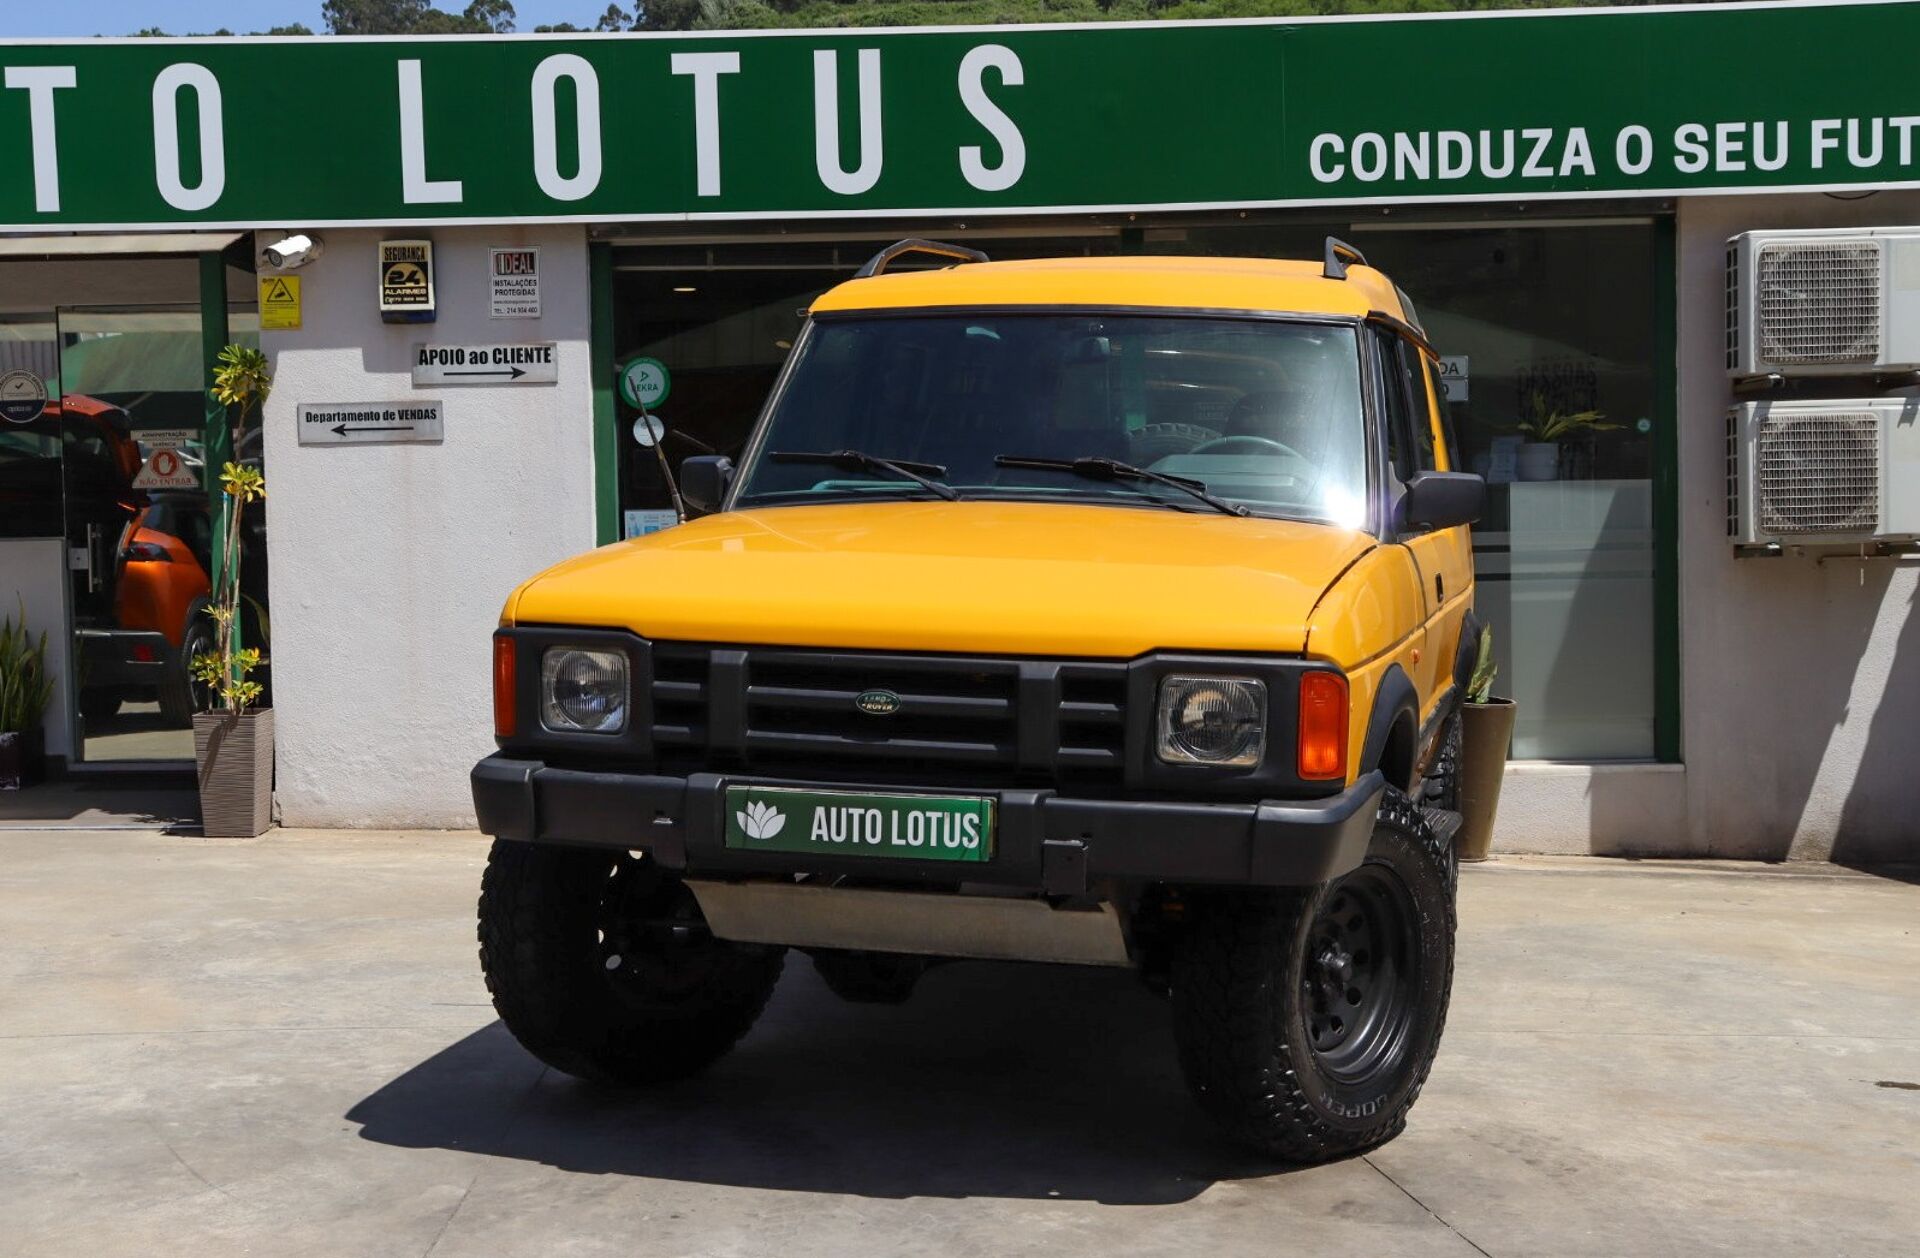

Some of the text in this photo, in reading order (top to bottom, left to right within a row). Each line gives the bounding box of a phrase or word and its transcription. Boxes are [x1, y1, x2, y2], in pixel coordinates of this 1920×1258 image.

[397, 43, 1026, 204] LOTUS
[1309, 115, 1920, 183] CONDUZA O SEU FUT
[388, 270, 421, 286] 24
[493, 278, 537, 288] INSTALAÇÕES
[494, 288, 536, 296] PROTEGIDAS
[419, 346, 552, 365] APOIO ao CLIENTE
[633, 383, 659, 392] EKRA
[305, 408, 437, 424] Departamento de VENDAS
[139, 477, 192, 486] NÃO ENTRAR
[810, 806, 980, 849] AUTO LOTUS
